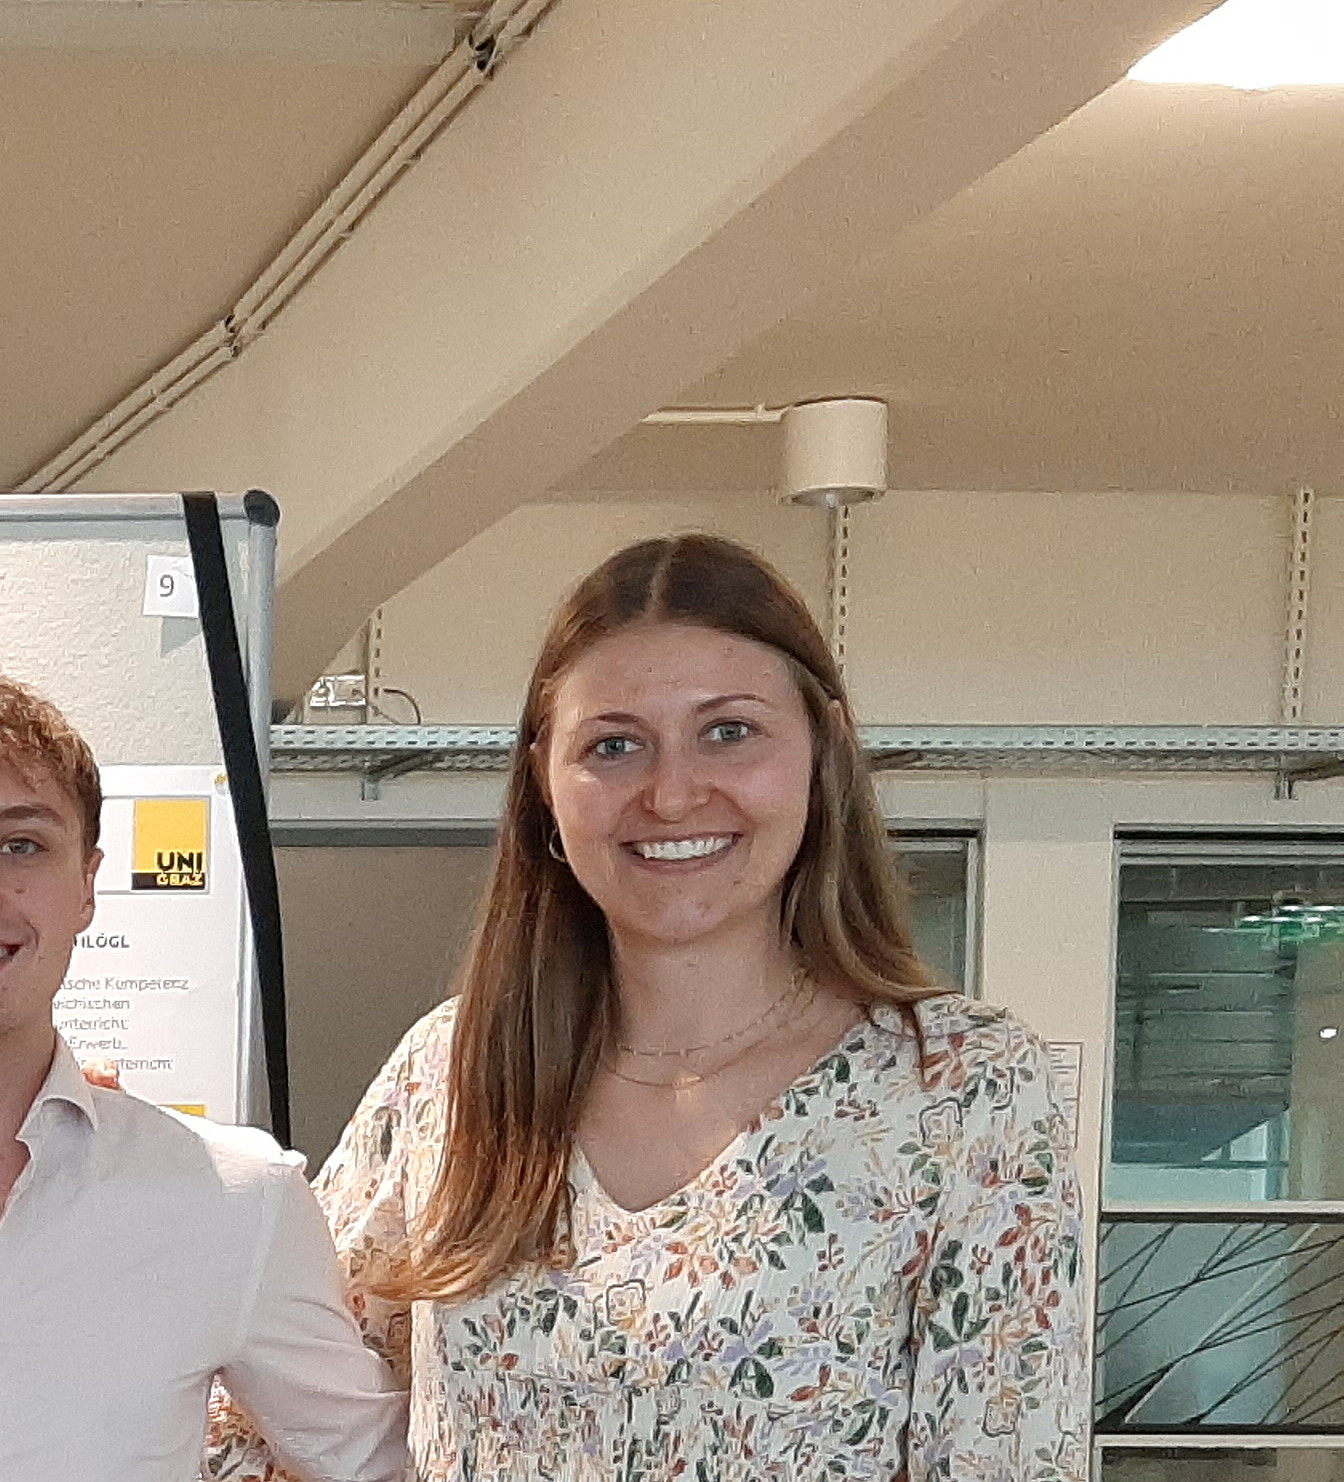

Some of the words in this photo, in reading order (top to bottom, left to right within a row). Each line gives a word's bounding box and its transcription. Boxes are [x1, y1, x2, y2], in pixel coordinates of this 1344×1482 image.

[160, 574, 174, 597] 9
[156, 852, 203, 872] UNI
[156, 874, 204, 886] GRAZ
